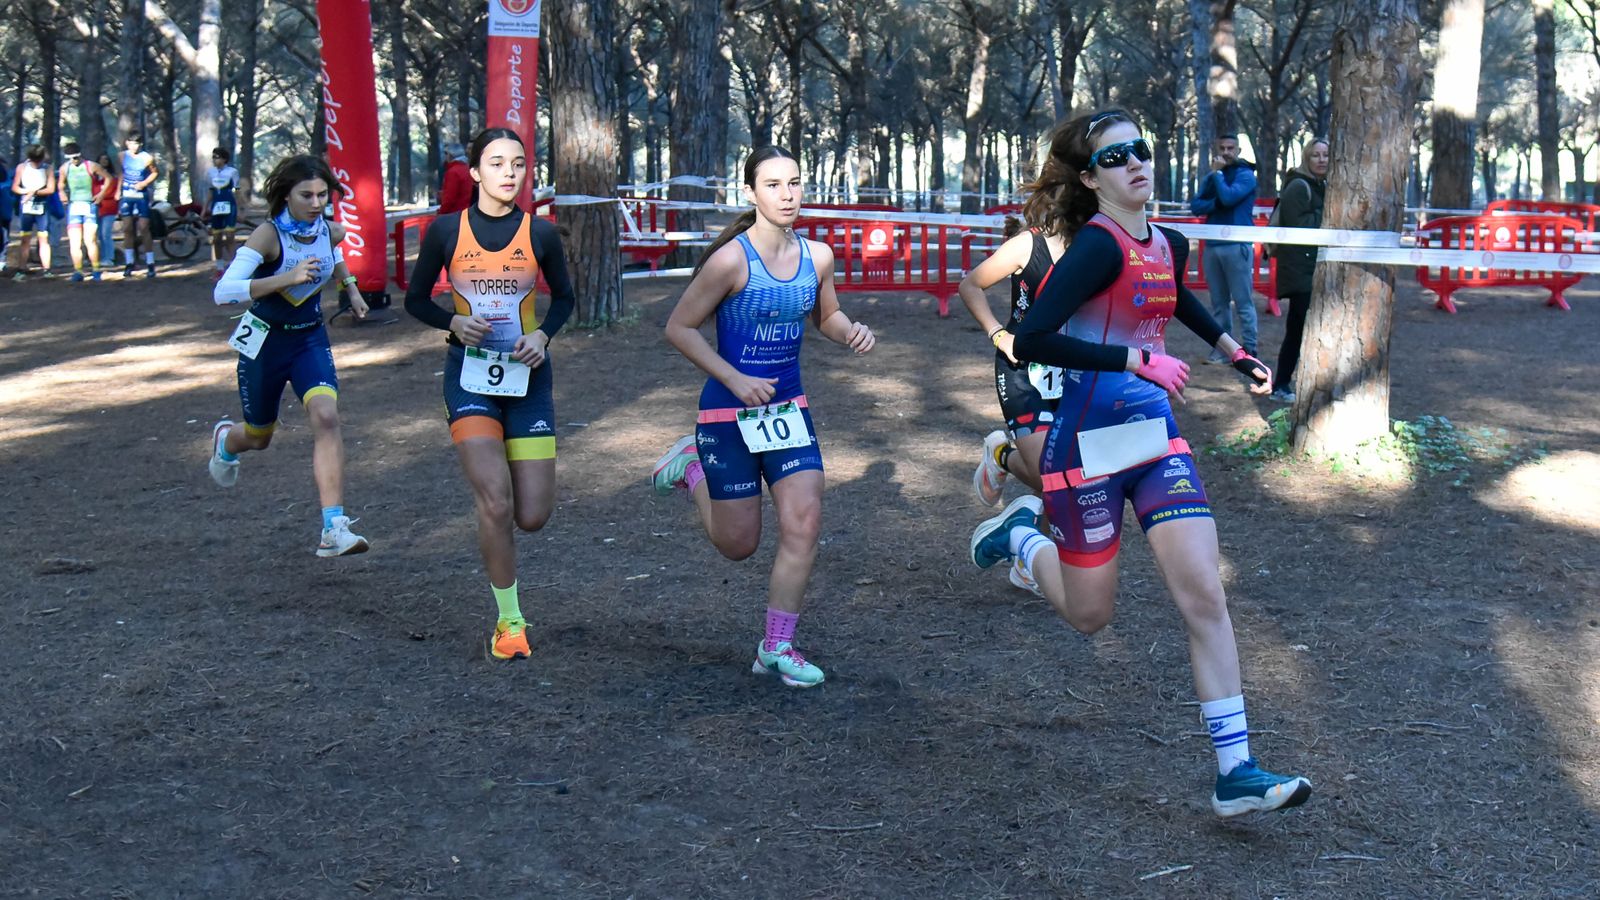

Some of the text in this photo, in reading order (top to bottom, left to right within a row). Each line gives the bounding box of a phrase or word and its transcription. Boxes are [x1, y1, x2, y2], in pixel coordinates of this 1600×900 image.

[506, 44, 526, 125] Deporte
[470, 279, 519, 296] TORRES
[235, 325, 253, 346] 2
[754, 321, 800, 342] NIETO
[487, 364, 505, 387] 9
[756, 417, 791, 443] 10
[734, 481, 757, 491] EDM
